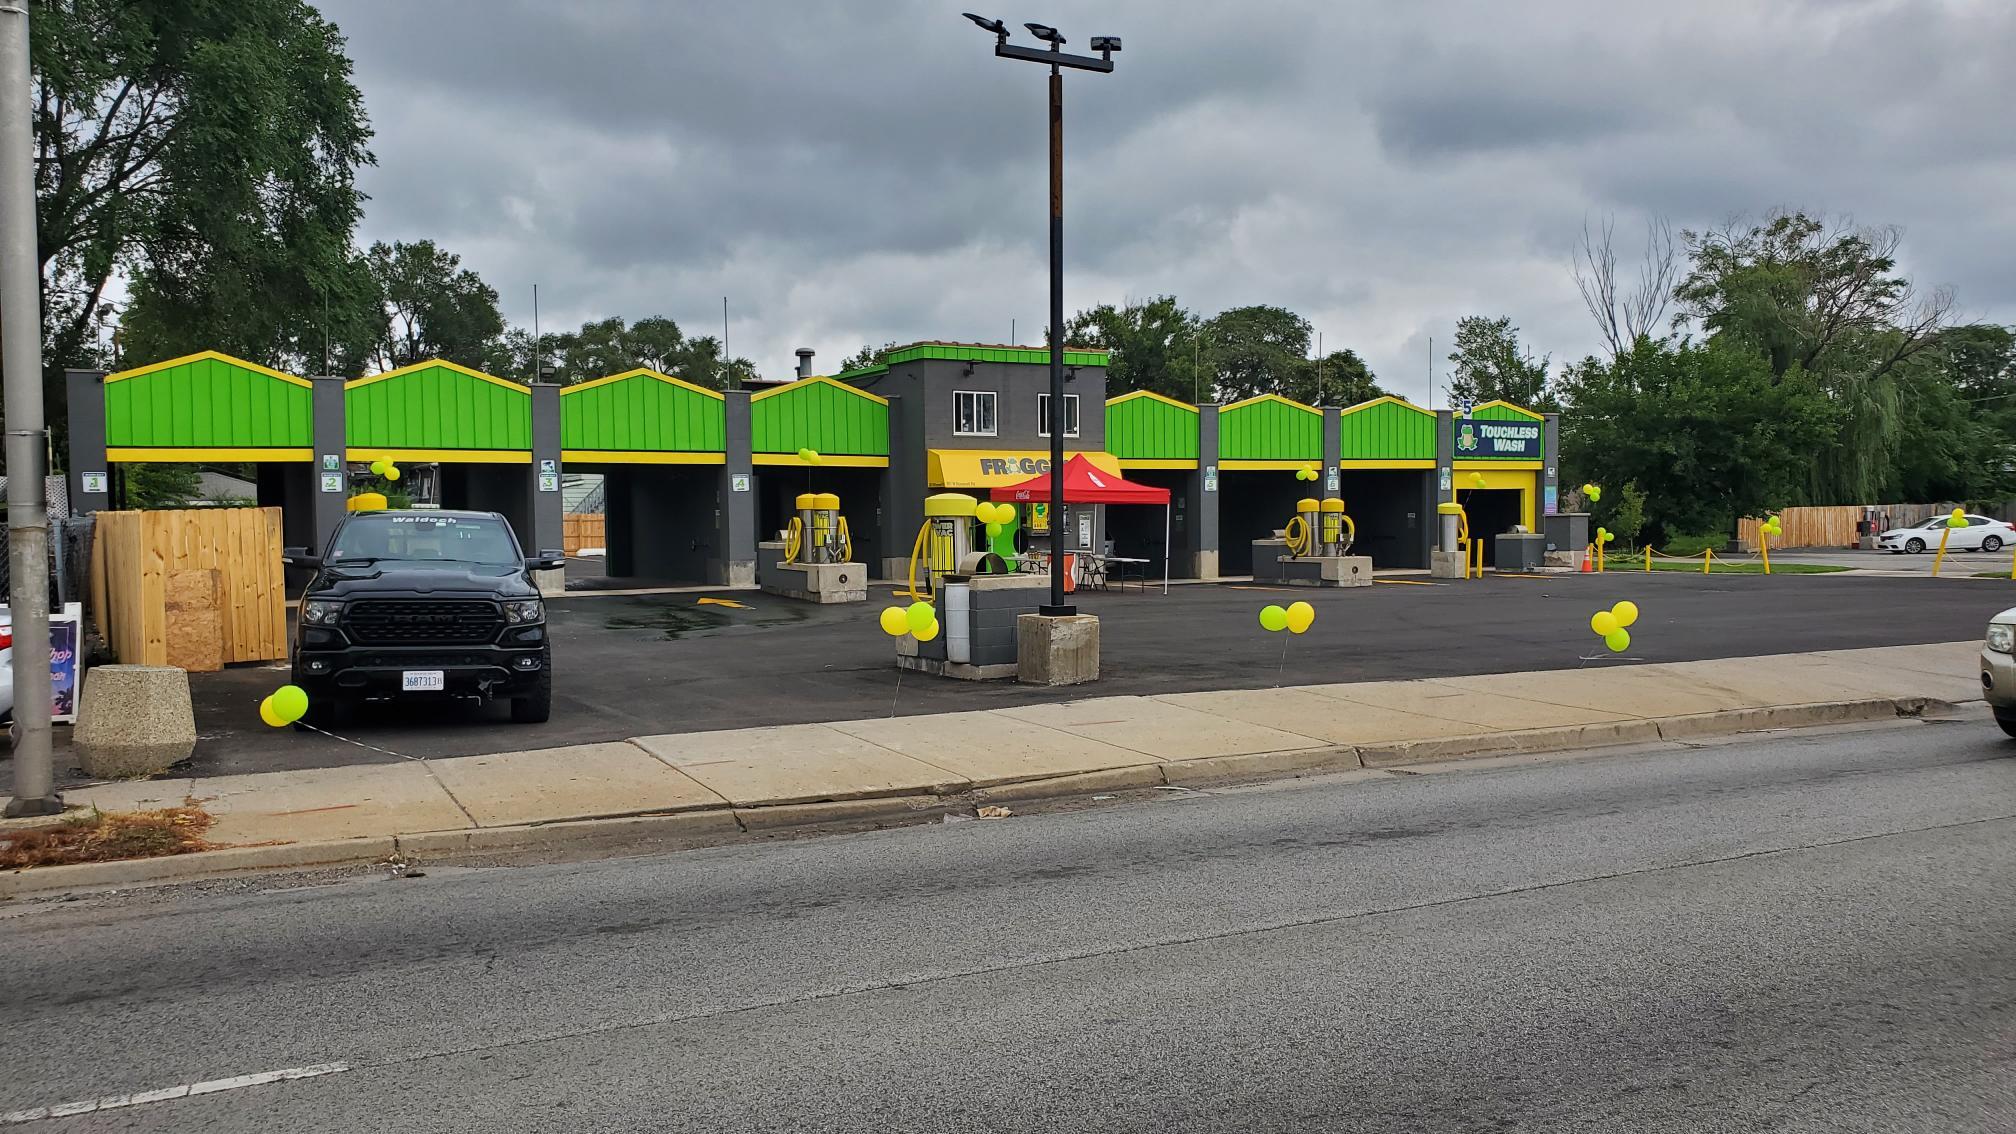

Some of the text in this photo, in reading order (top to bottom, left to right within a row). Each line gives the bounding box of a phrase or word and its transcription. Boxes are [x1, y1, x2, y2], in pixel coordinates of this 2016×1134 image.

[1480, 425, 1539, 439] TOUCHLESS
[1494, 439, 1526, 452] WASH
[328, 477, 337, 487] 2
[545, 477, 552, 487] 3
